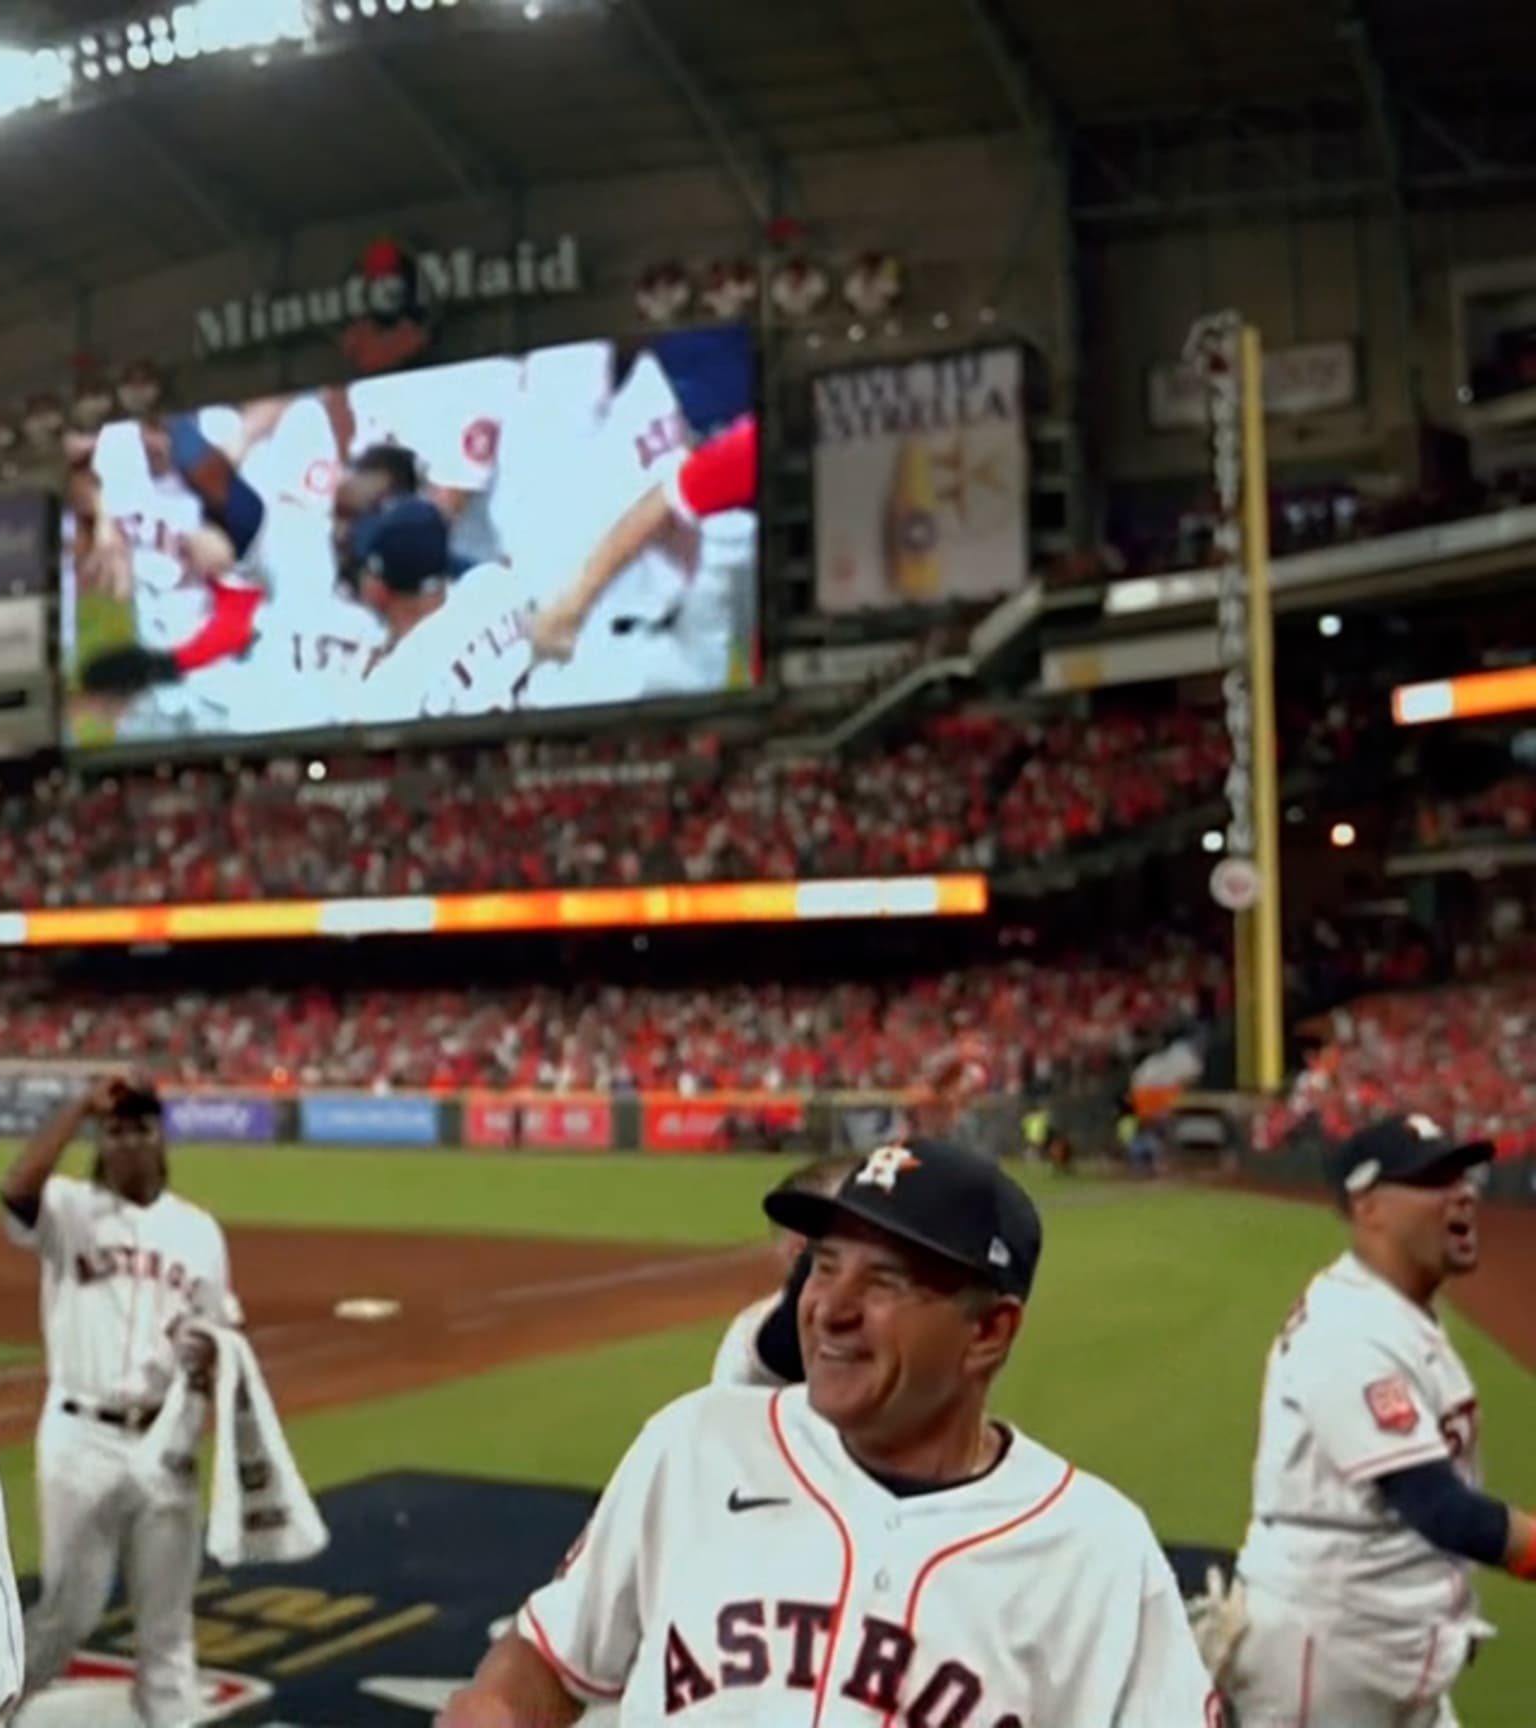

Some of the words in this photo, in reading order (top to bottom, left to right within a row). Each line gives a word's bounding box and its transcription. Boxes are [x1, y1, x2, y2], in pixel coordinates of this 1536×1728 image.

[193, 272, 407, 357] Minute
[417, 235, 581, 305] Maid
[664, 1599, 1025, 1728] ASTRO
